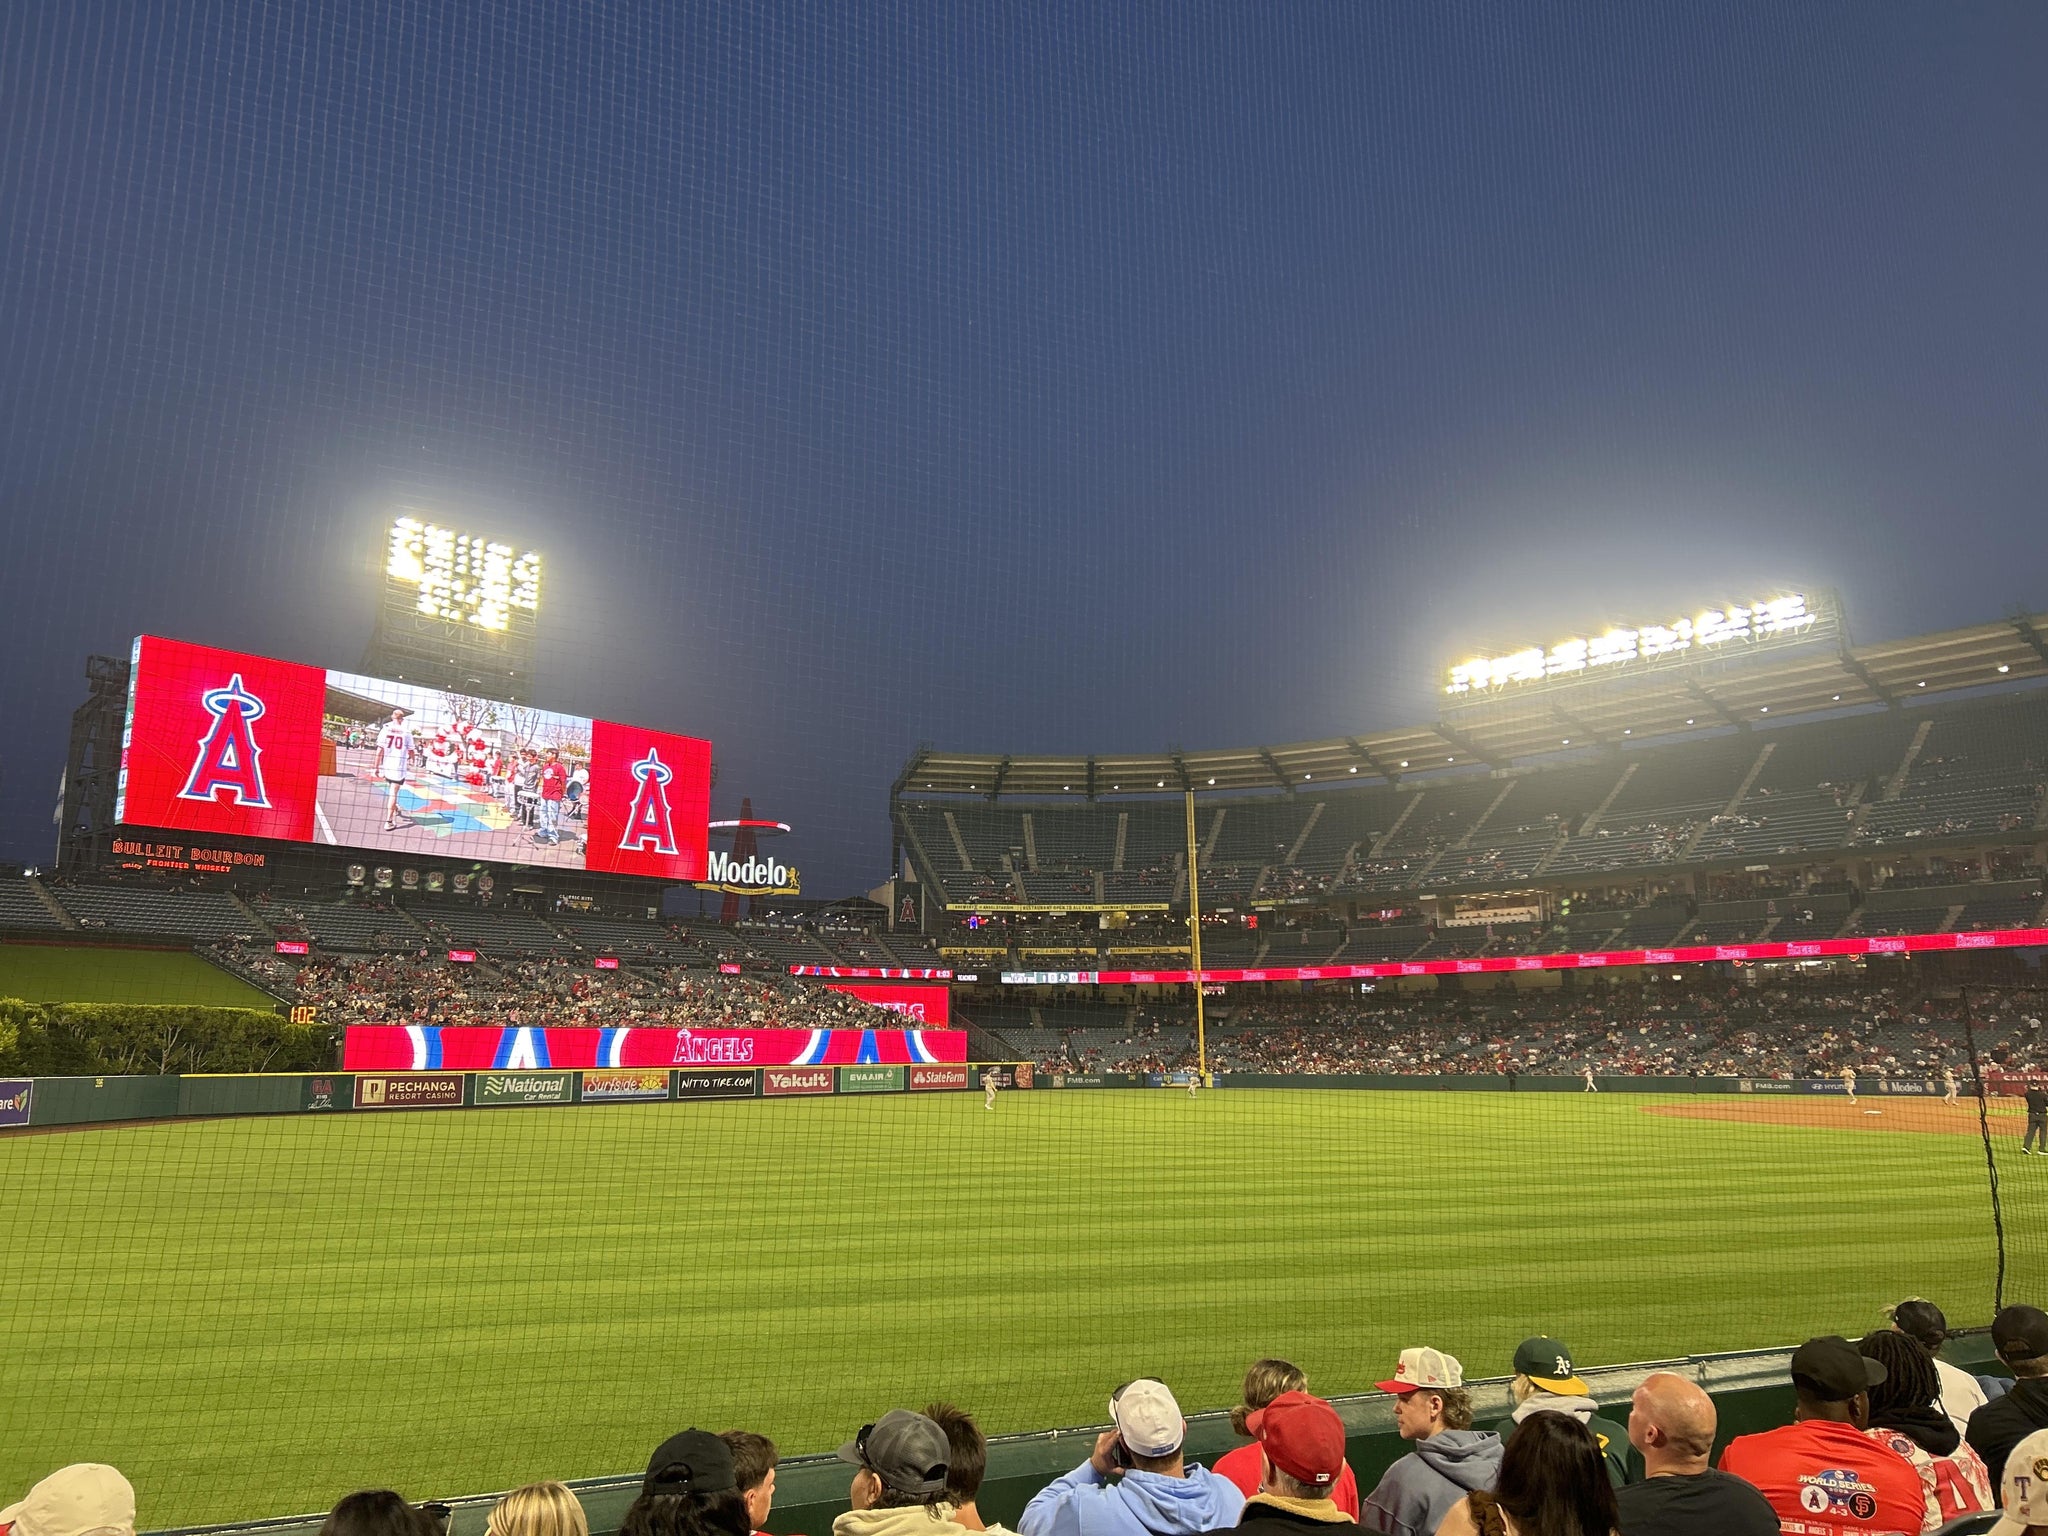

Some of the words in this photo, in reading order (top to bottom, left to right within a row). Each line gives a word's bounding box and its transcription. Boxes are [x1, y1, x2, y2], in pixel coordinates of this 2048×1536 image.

[386, 735, 403, 749] 70
[112, 840, 184, 859] BULLEIT
[190, 847, 265, 867] BOURBON
[146, 859, 190, 870] FRONTIER
[708, 850, 787, 886] Modelo
[455, 876, 467, 886] 42
[480, 878, 492, 888] 50
[291, 1006, 316, 1024] 1:02
[673, 1029, 754, 1063] ANGELS
[681, 1077, 710, 1089] NITTO
[711, 1076, 753, 1087] TIRE.COM
[769, 1073, 829, 1088] Yakult
[869, 1073, 884, 1081] AIR
[389, 1082, 456, 1092] PECHANGA
[503, 1077, 565, 1093] National
[587, 1075, 638, 1094] Surfside
[1891, 1082, 1922, 1092] Modelo
[538, 1092, 561, 1100] Rental
[1798, 1474, 1838, 1487] WORLD
[1838, 1480, 1877, 1493] SERIES
[2014, 1476, 2031, 1501] T
[1829, 1507, 1849, 1517] 4-3
